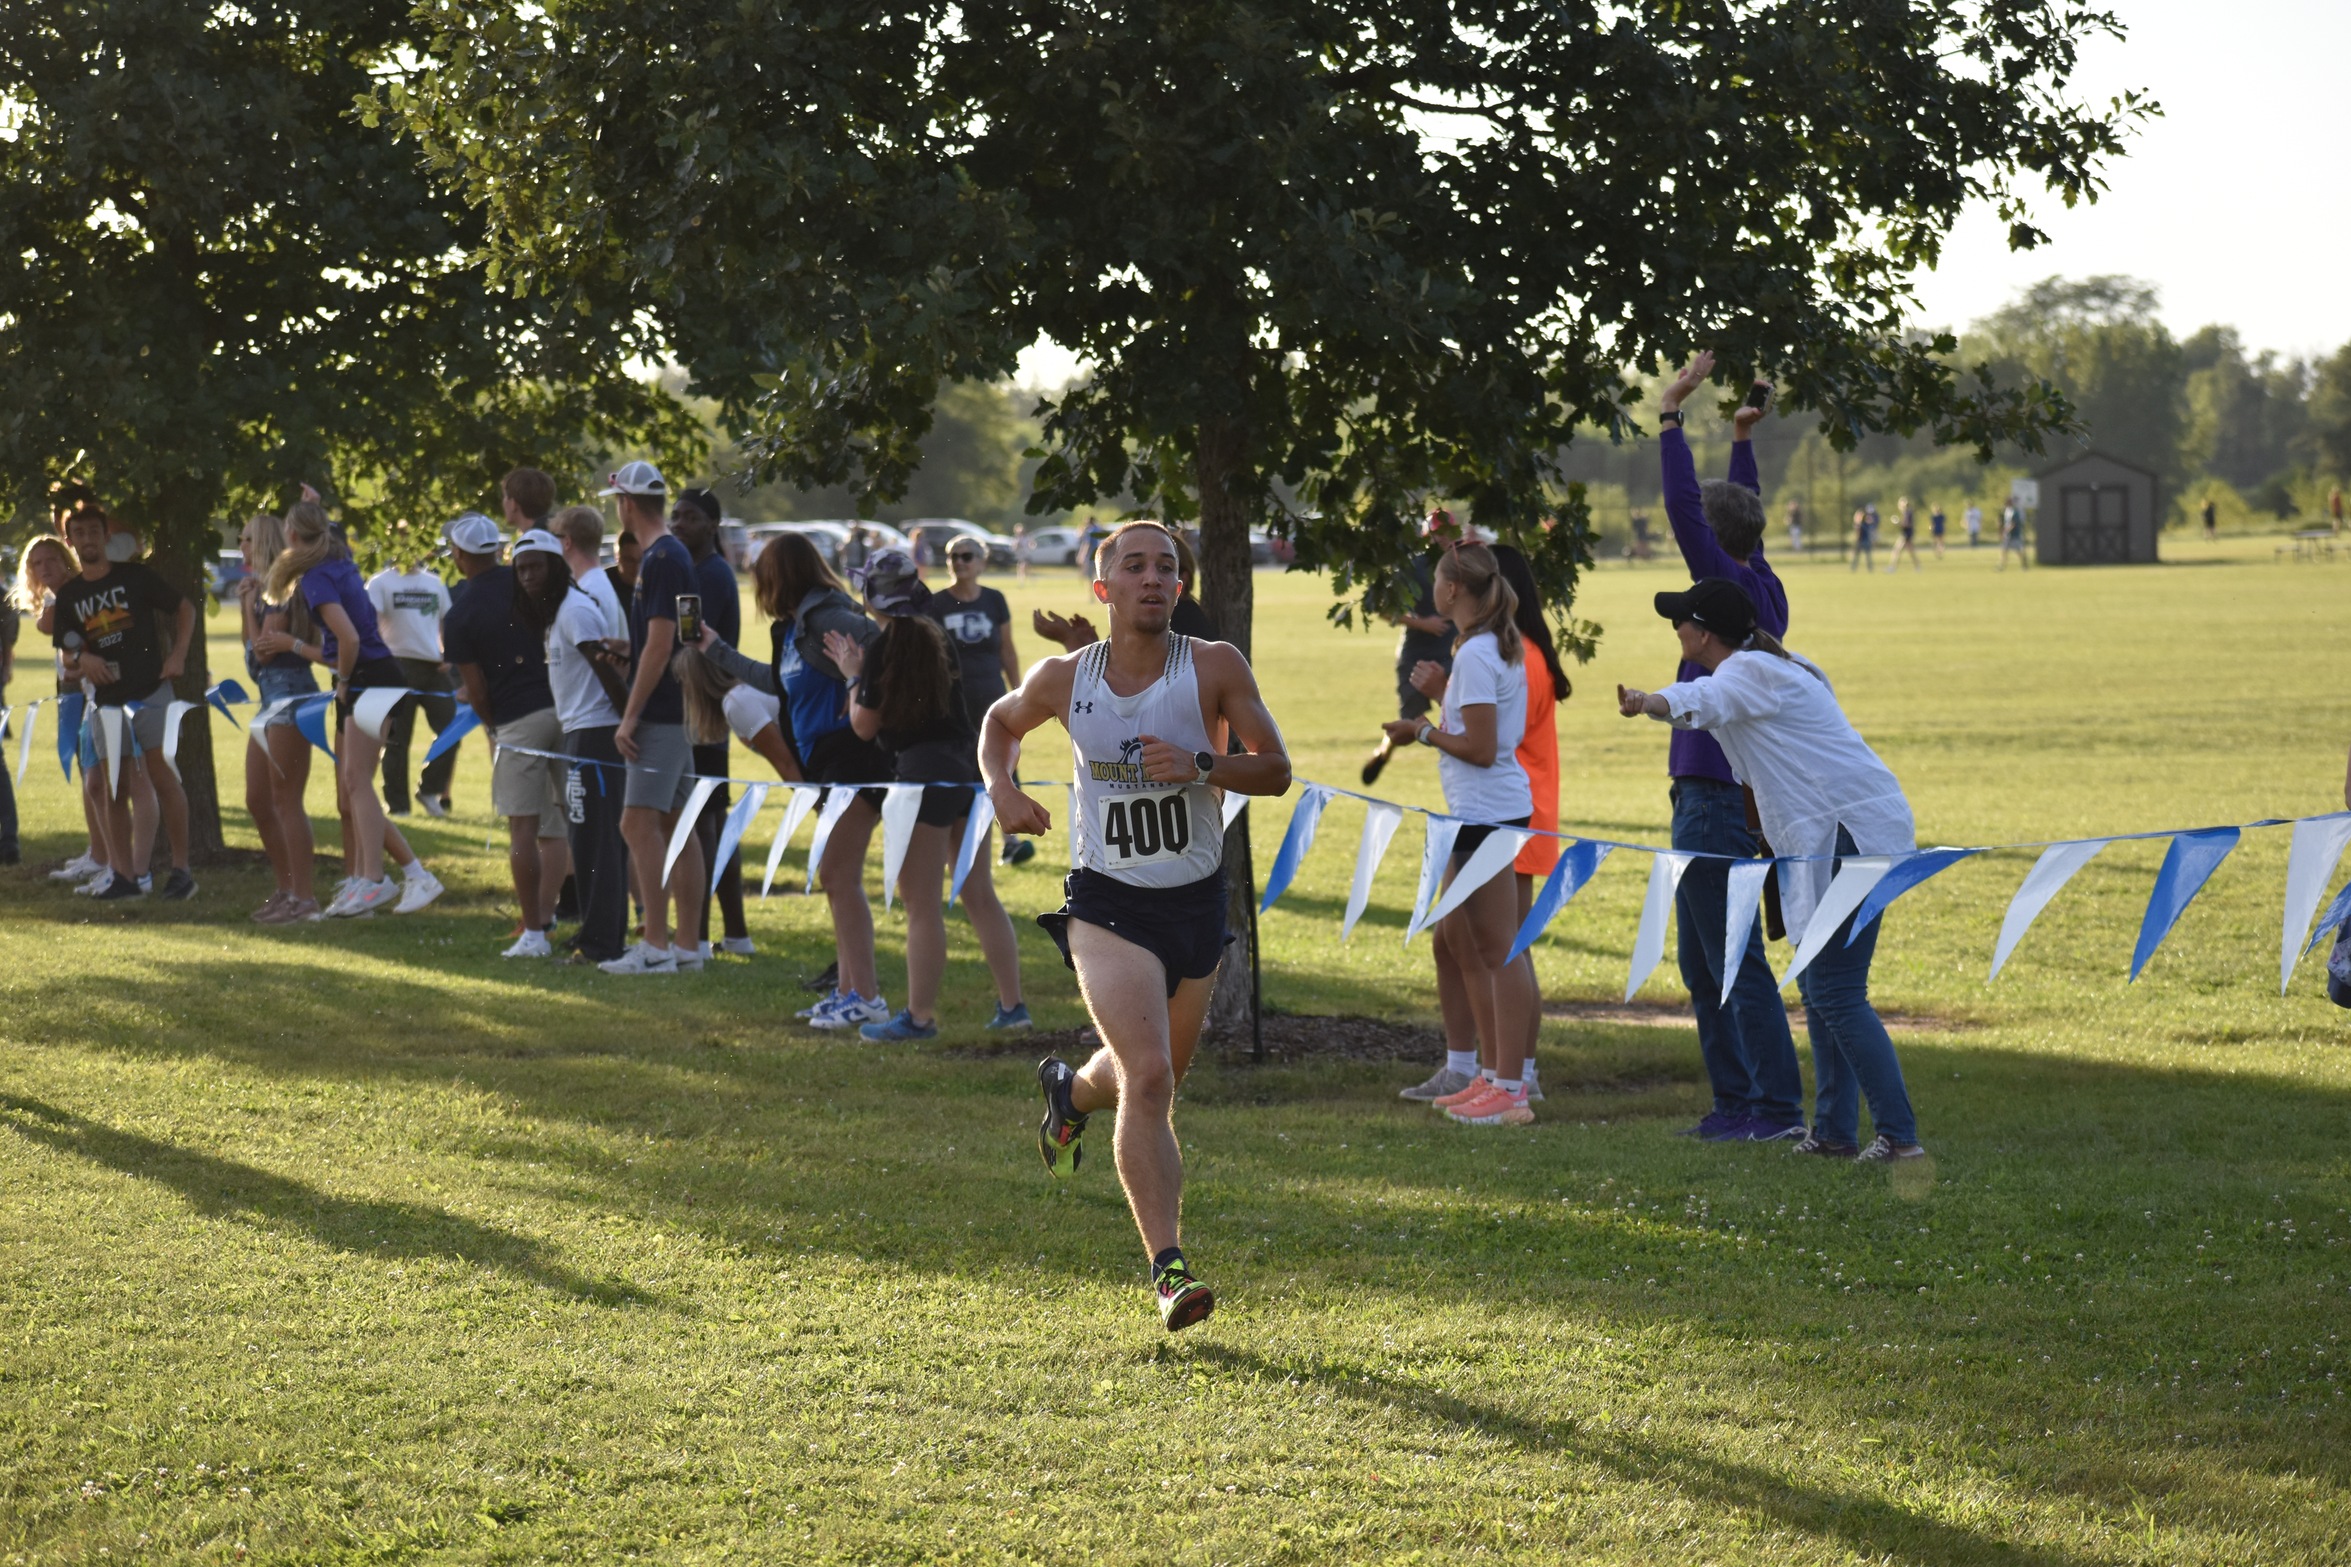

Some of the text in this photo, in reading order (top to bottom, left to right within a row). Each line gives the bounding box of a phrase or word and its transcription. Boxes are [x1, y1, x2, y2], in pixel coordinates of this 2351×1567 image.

[74, 586, 129, 623] WXC
[98, 631, 123, 648] 2022
[1089, 760, 1139, 783] MOUNT
[1105, 795, 1189, 859] 400
